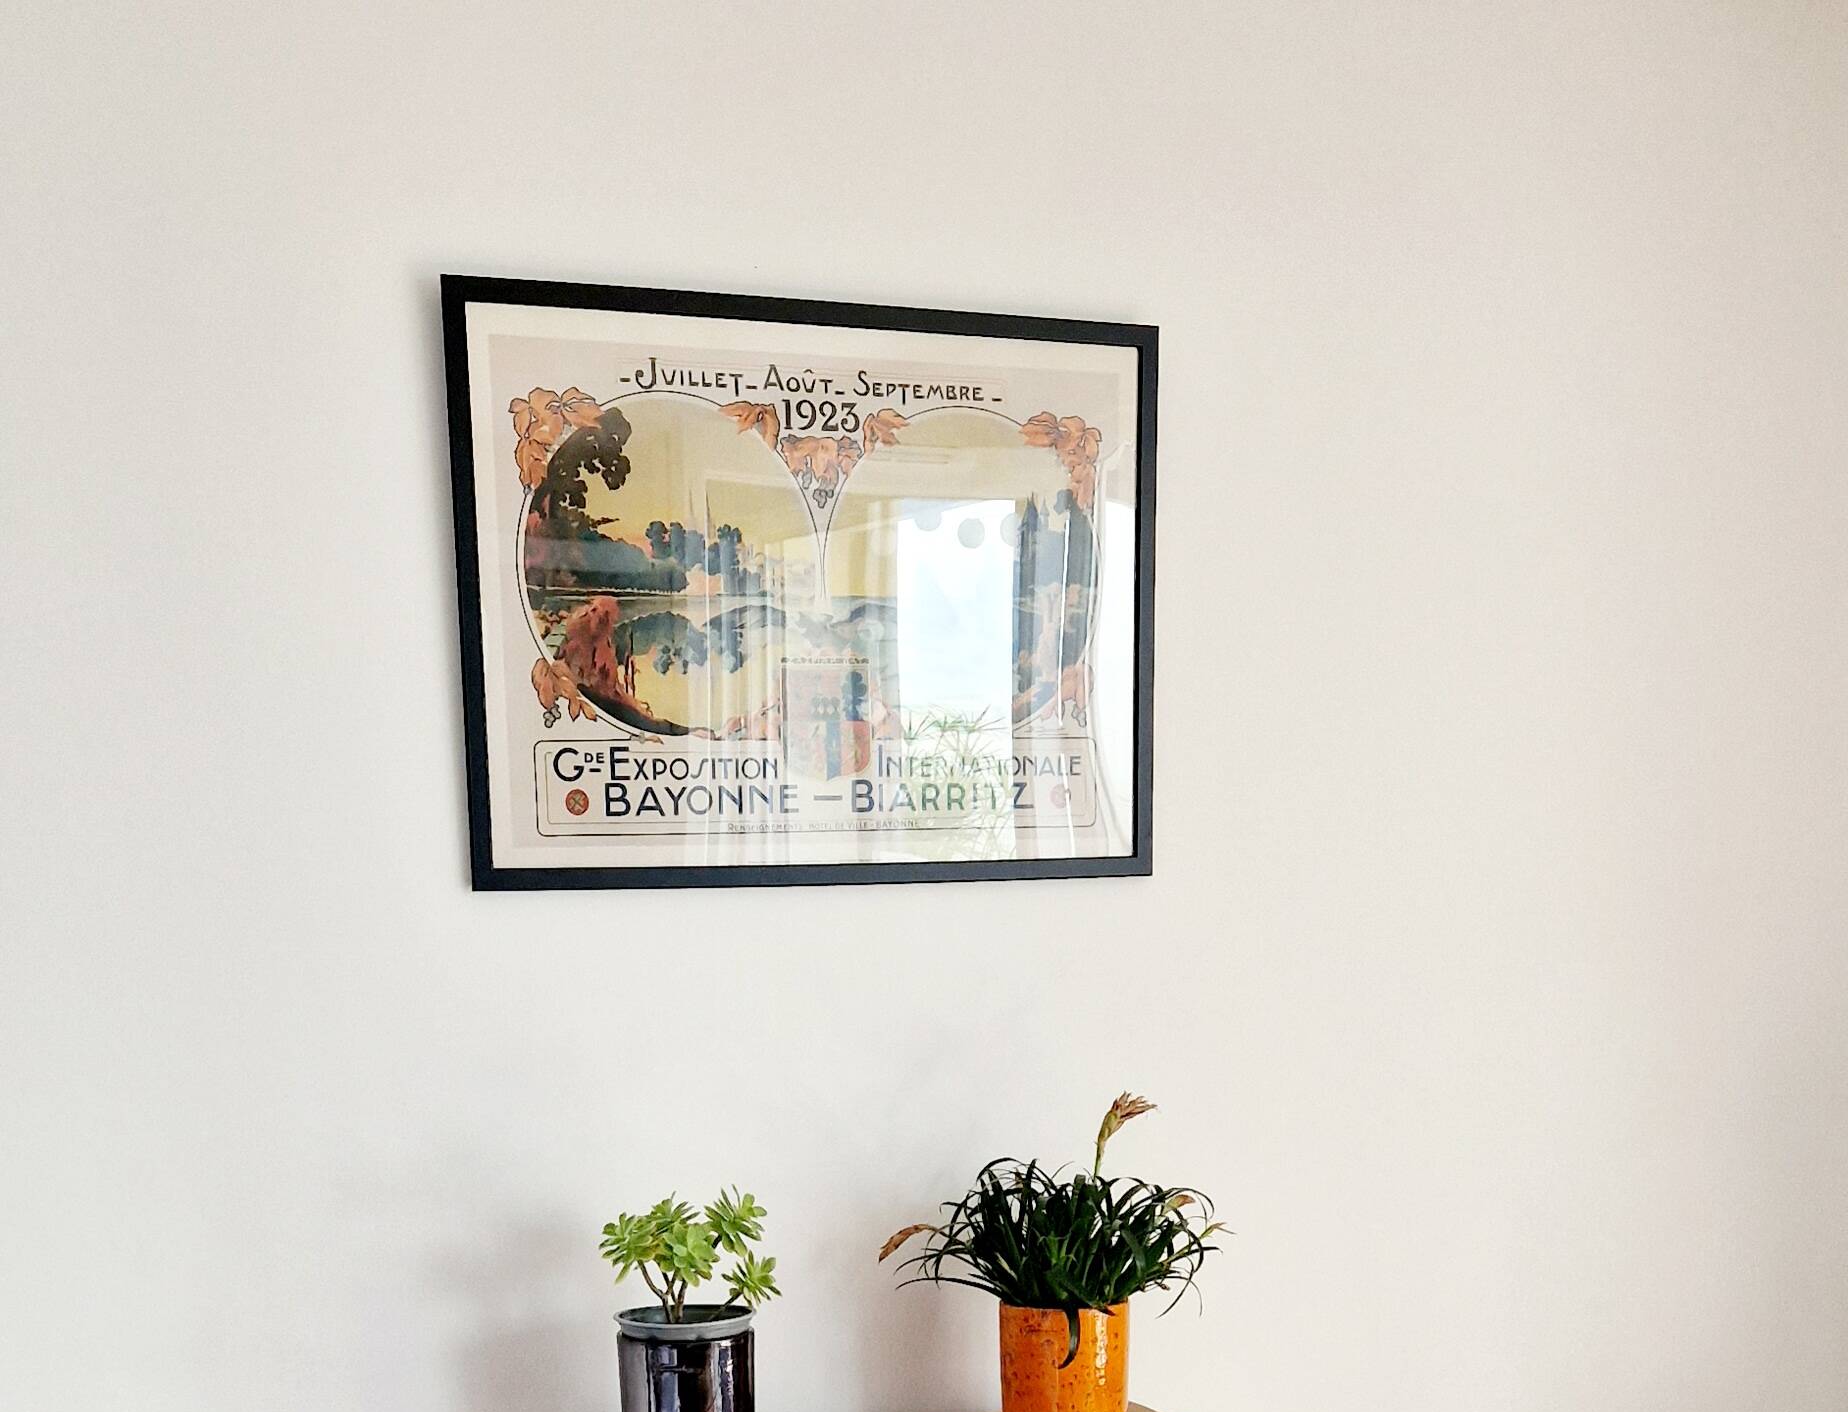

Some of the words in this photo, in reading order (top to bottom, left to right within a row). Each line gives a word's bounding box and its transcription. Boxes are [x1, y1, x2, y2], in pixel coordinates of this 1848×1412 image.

[853, 370, 985, 405] SEPTEMBRE
[781, 399, 860, 433] 1923
[609, 746, 779, 781] EXPOSITION
[877, 744, 1082, 777] INTERNATIONALE
[604, 782, 801, 817] BAYONNE
[851, 779, 1034, 813] BIARRITZ
